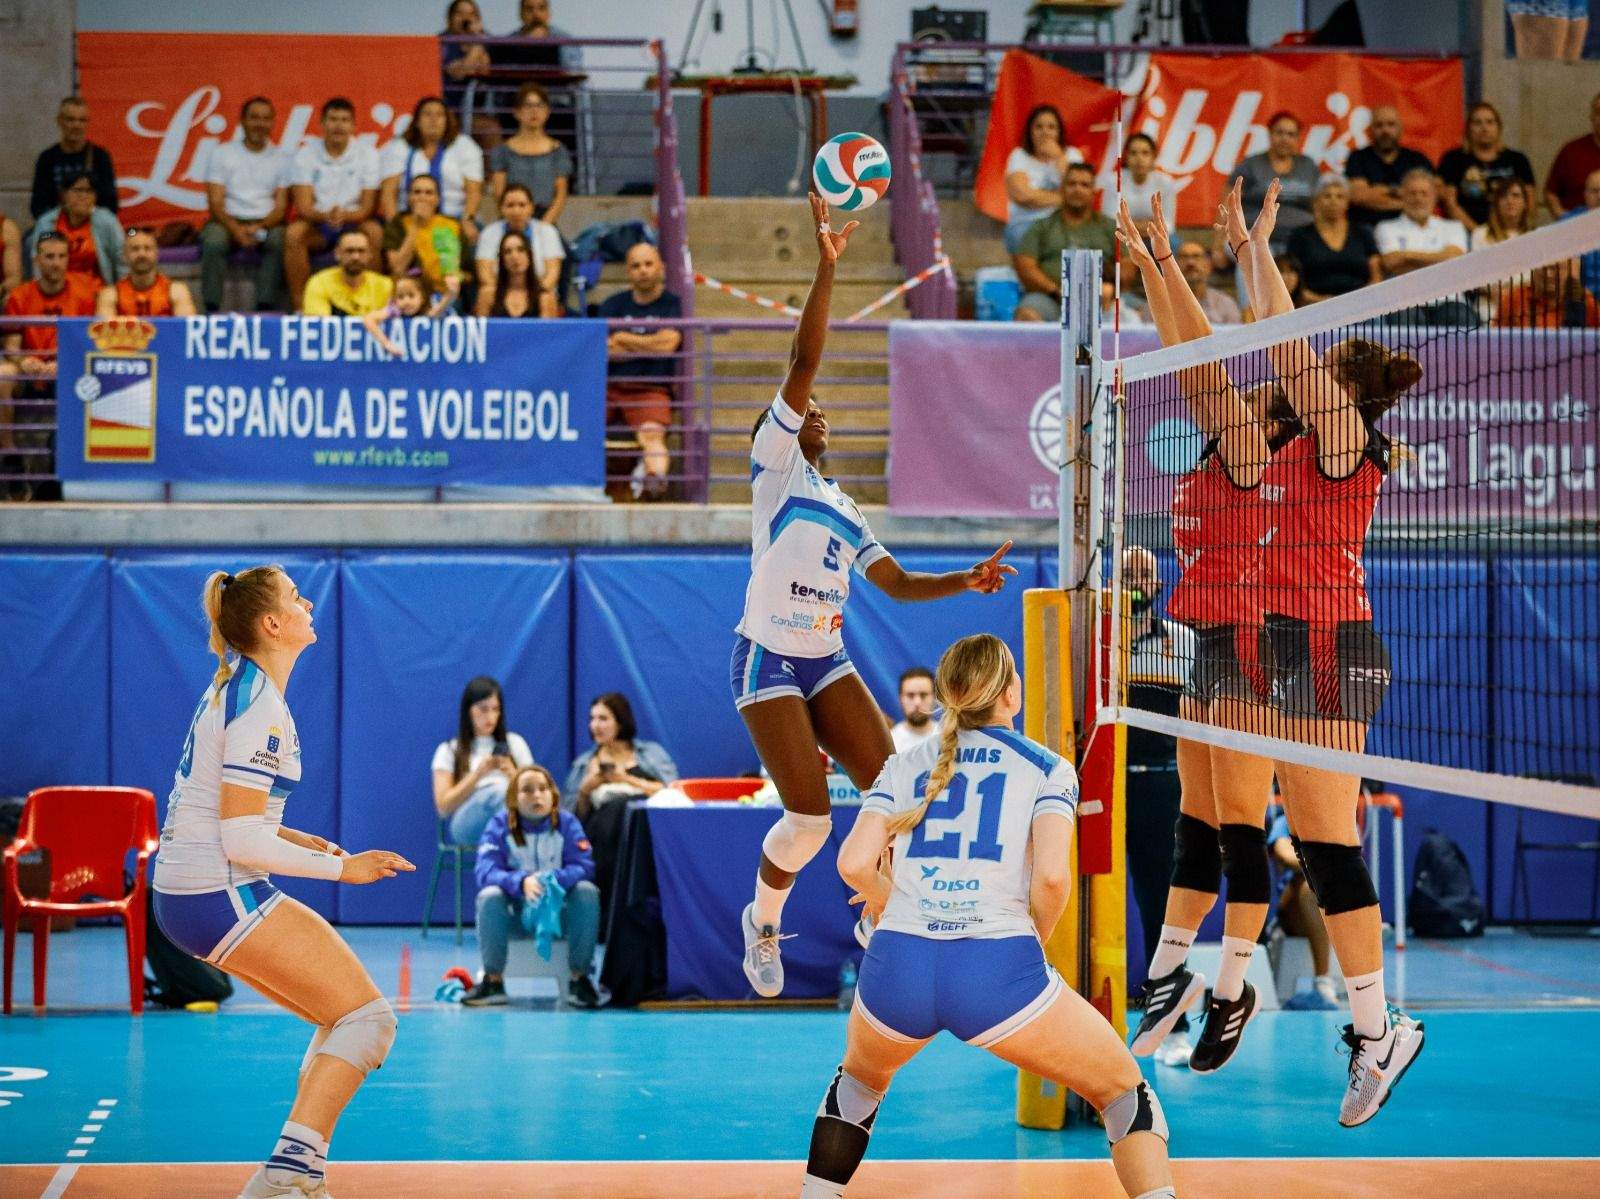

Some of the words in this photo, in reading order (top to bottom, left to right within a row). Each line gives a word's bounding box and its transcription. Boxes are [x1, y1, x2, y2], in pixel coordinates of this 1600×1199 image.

[186, 315, 271, 360] REAL
[94, 359, 149, 375] RFEVB
[183, 376, 357, 438] ESPAÑOLA
[365, 388, 409, 440] DE
[418, 388, 579, 442] VOLEIBOL
[313, 446, 449, 468] www.rfevb.com
[823, 536, 841, 572] 5
[907, 769, 1009, 862] 21
[940, 922, 969, 932] GEFF
